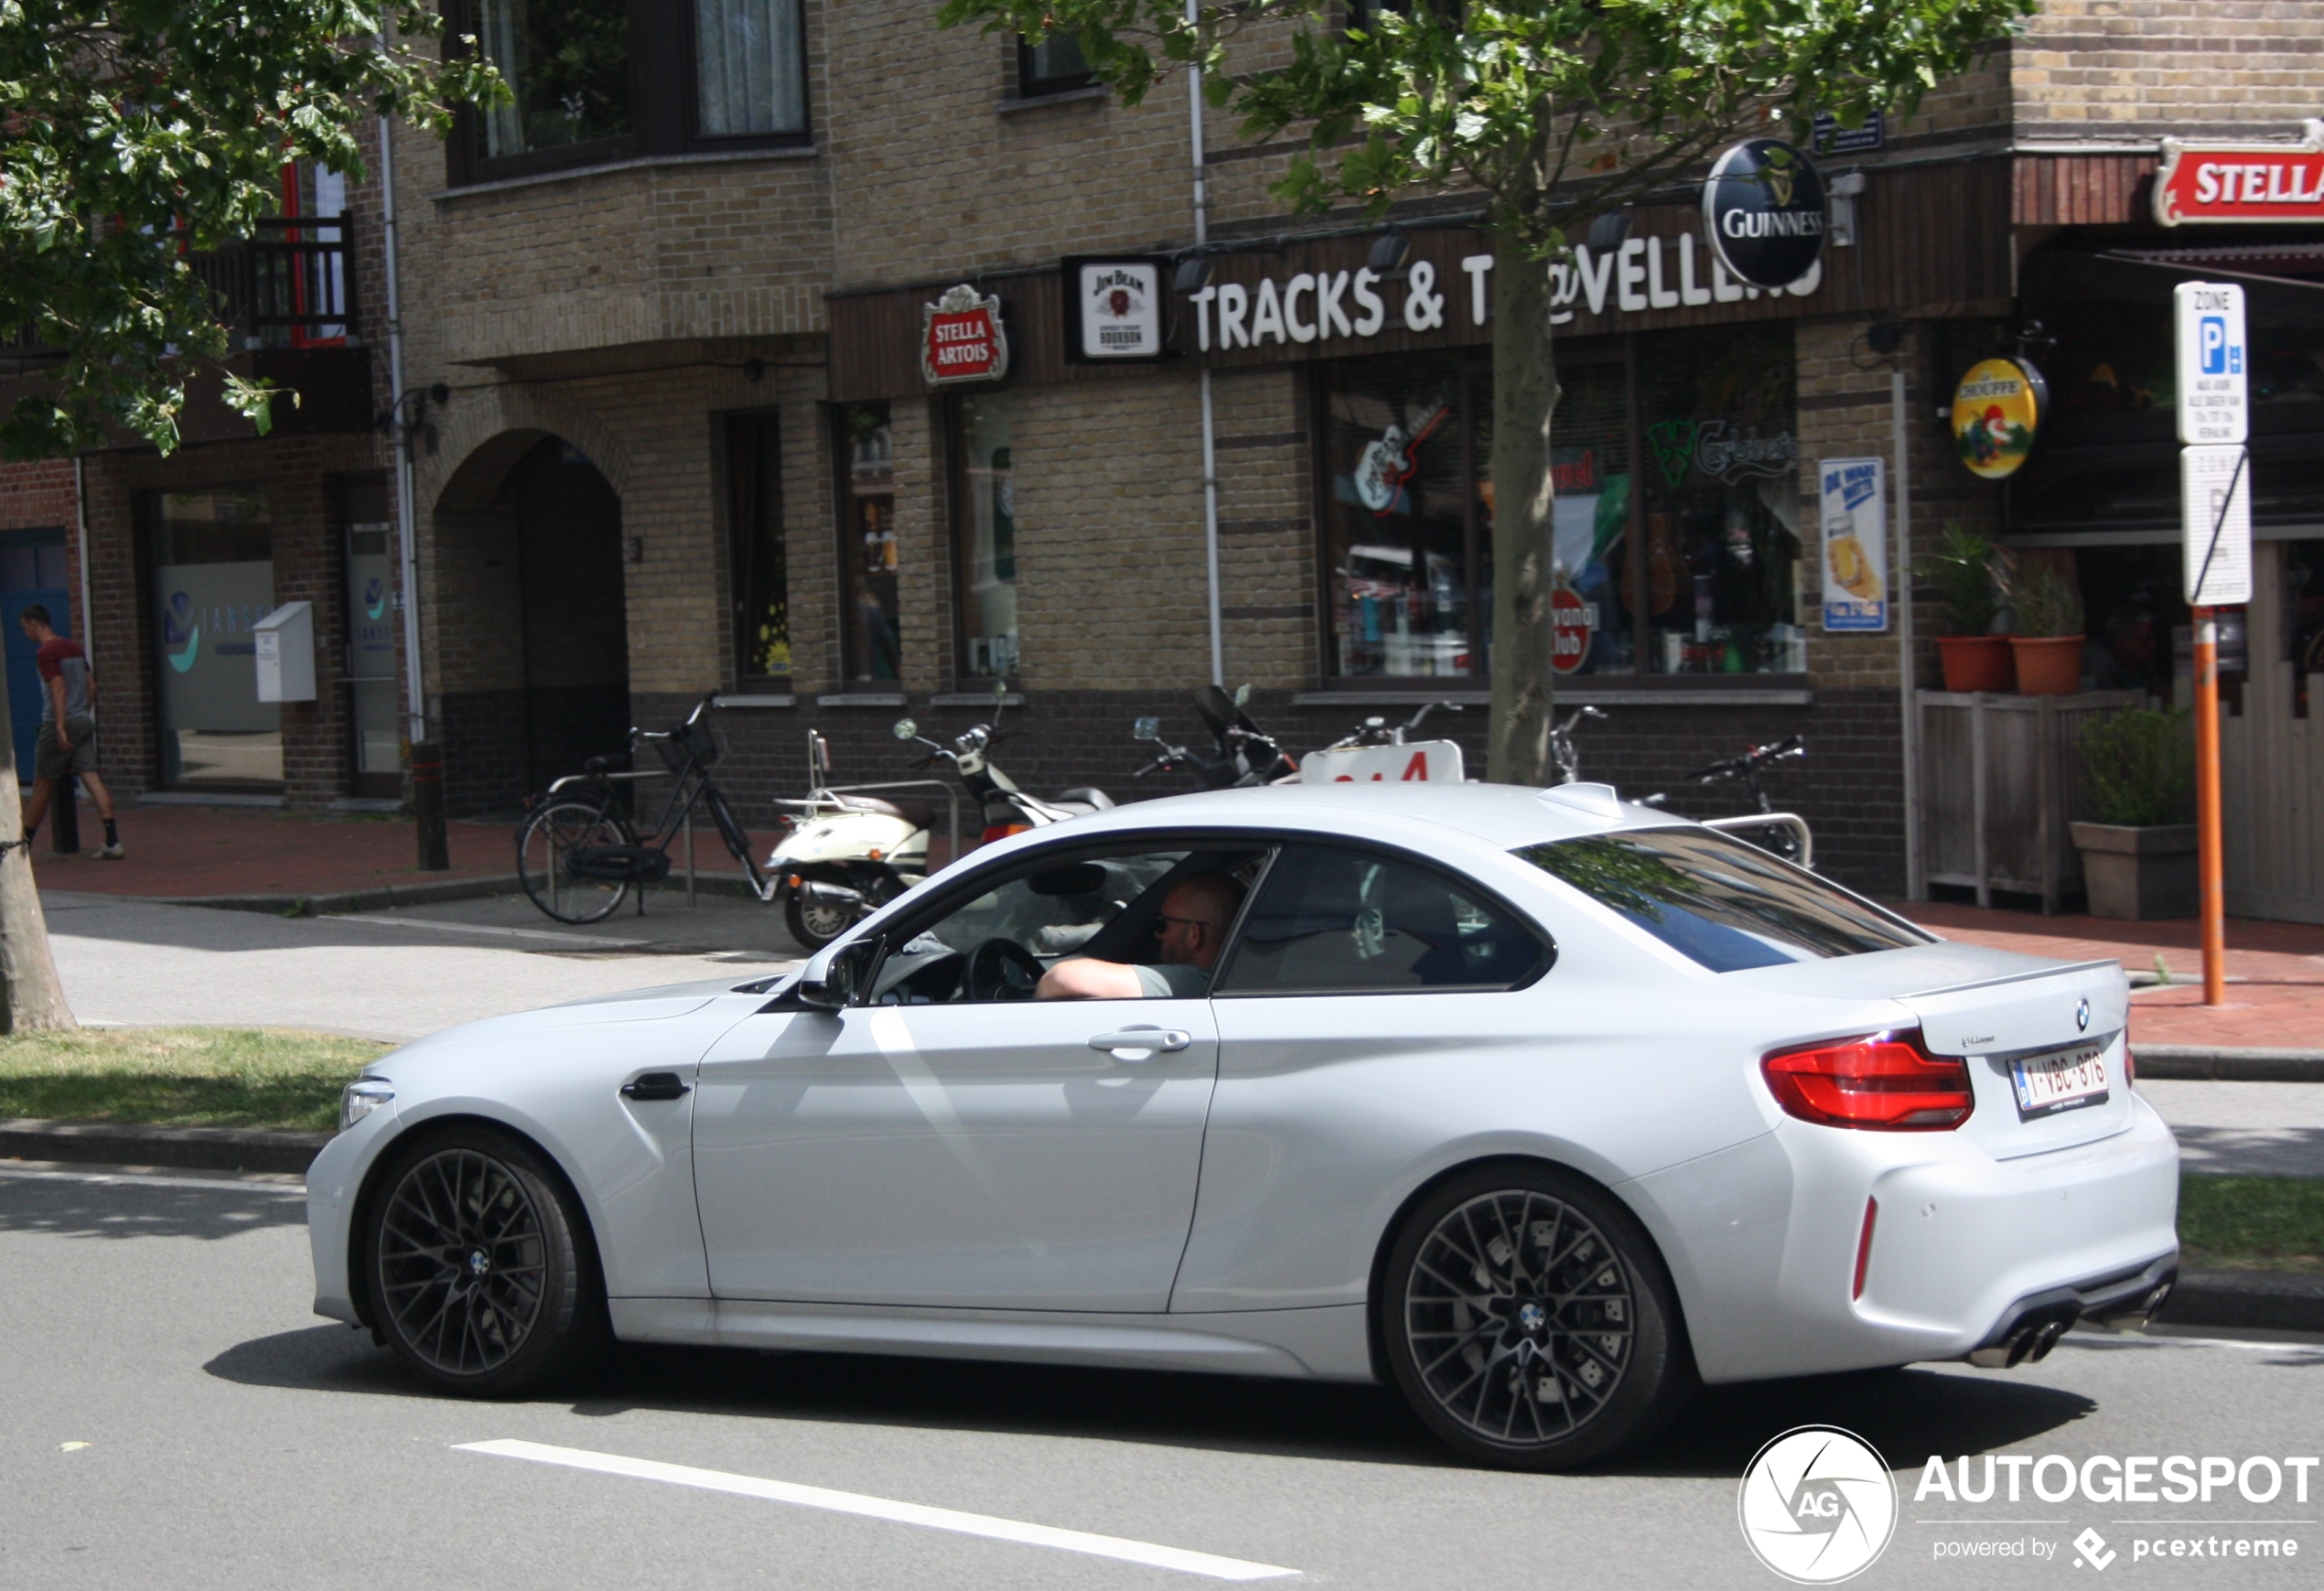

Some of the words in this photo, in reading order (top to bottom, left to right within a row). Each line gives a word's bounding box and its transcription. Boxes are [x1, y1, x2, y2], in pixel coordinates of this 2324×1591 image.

[1722, 209, 1823, 239] GUINNESS
[1115, 269, 1145, 296] BEAM
[1189, 266, 1384, 352] TRACKS
[1404, 260, 1444, 332] &
[2194, 291, 2231, 310] ZONE
[935, 320, 986, 343] STELLA
[1100, 331, 1142, 344] BOURBON
[938, 343, 989, 365] ARTOIS
[2202, 321, 2223, 369] P
[201, 604, 276, 633] JANSS
[1552, 607, 1593, 627] vana
[1552, 629, 1581, 654] lub
